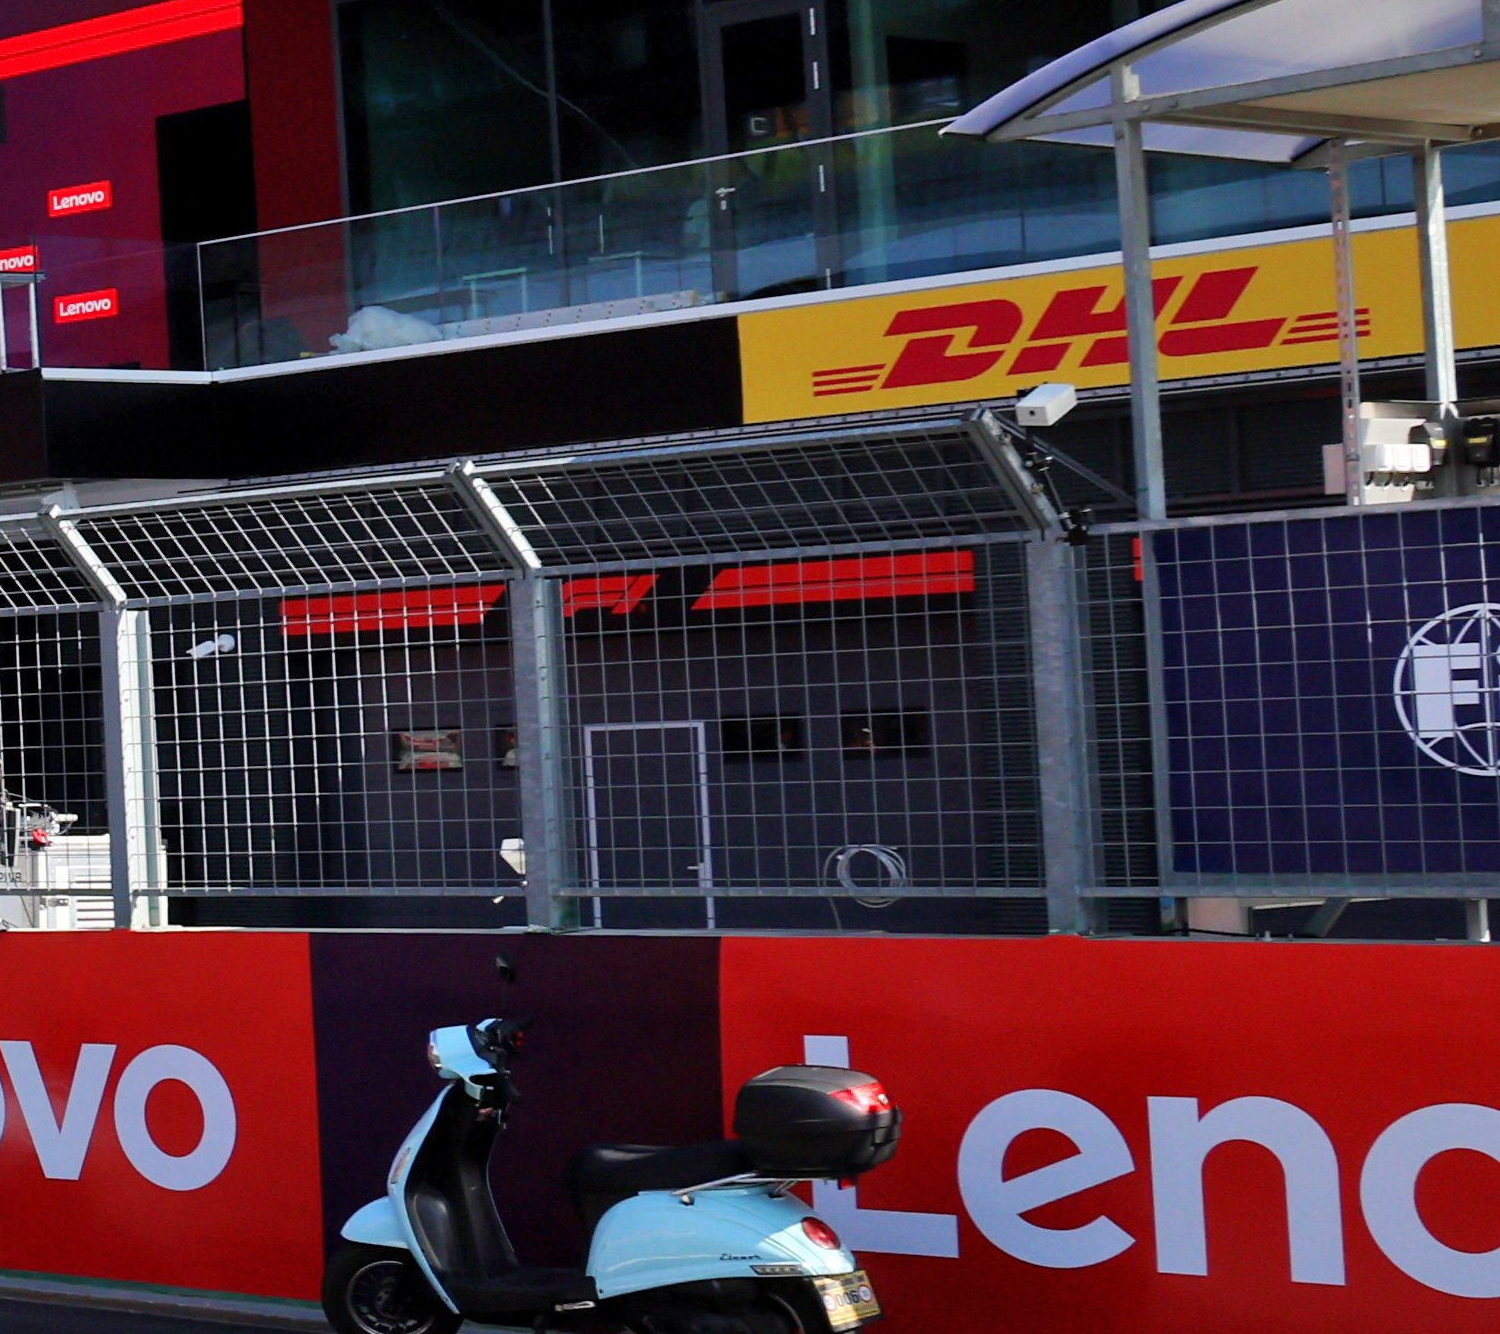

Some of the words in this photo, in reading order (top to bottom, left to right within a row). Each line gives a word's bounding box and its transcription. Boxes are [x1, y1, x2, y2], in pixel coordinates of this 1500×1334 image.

[53, 188, 105, 210] Lenovo
[59, 295, 111, 317] Lenovo
[882, 266, 1289, 390] DHL
[803, 1034, 1500, 1299] Leno
